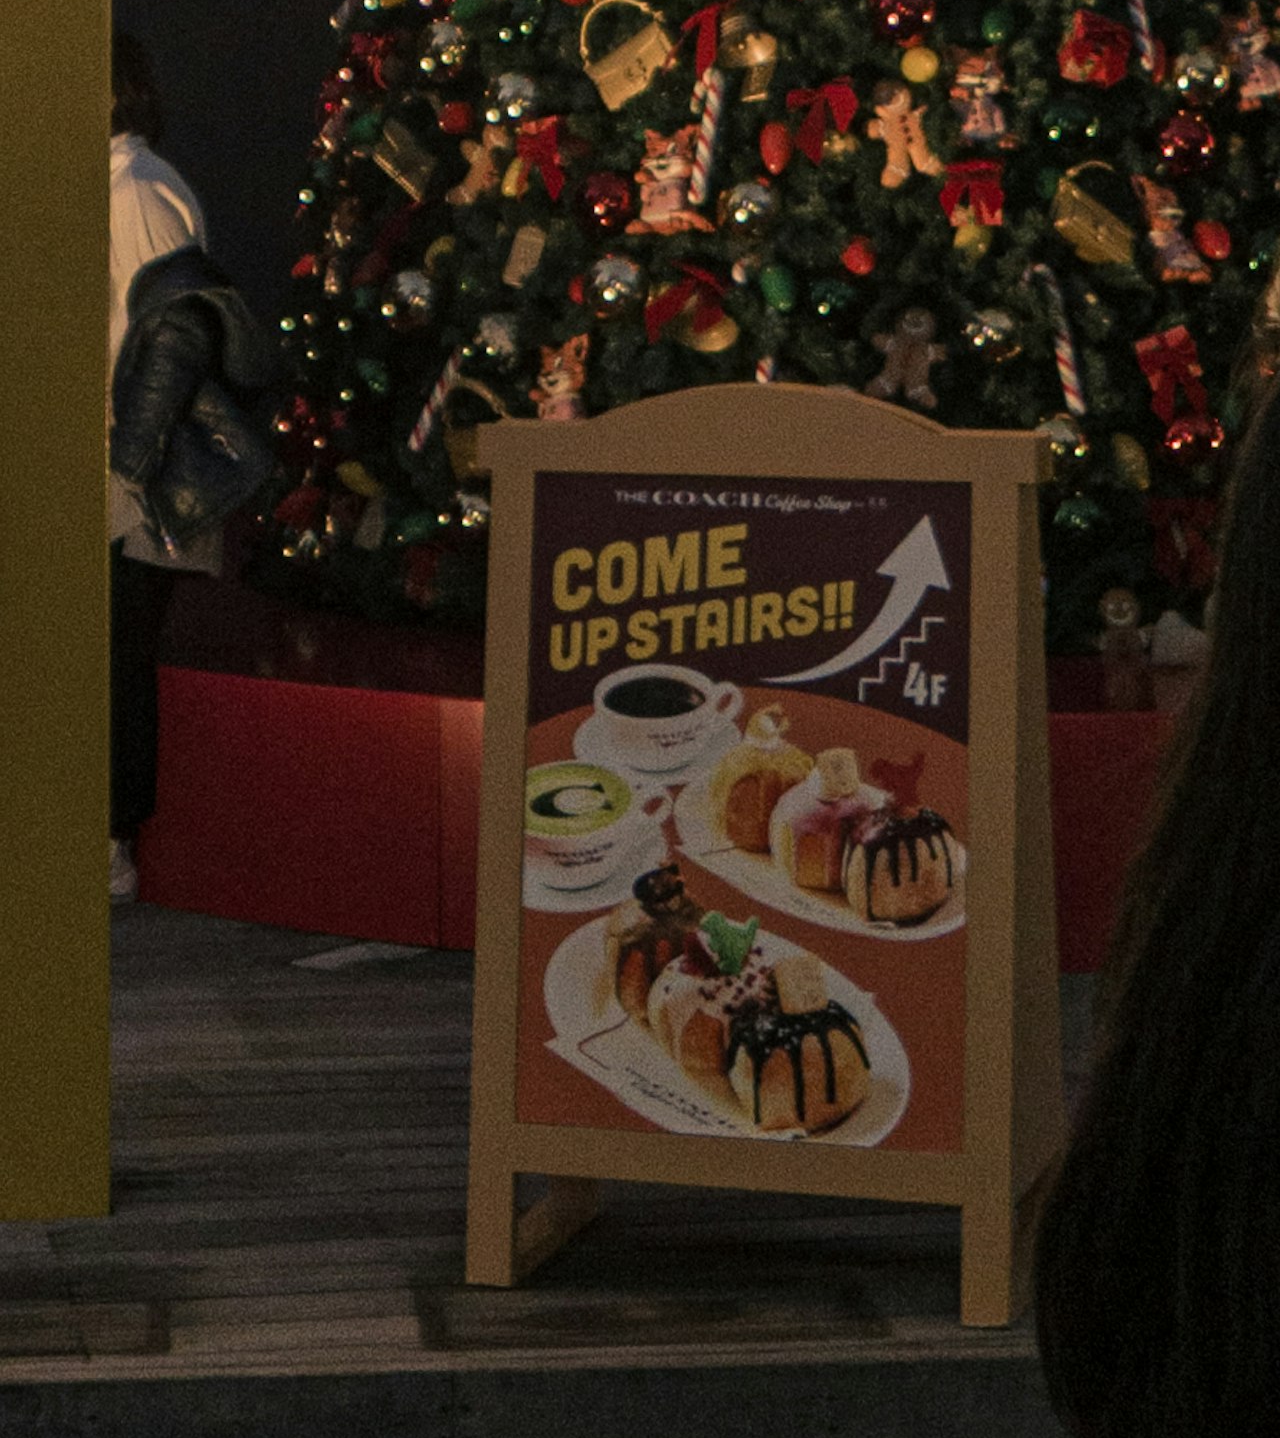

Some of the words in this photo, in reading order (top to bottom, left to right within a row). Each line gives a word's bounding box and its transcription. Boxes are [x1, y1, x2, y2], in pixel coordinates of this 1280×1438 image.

[615, 489, 648, 504] THE
[652, 490, 761, 508] COACH
[551, 523, 749, 612] COME
[903, 662, 949, 706] 4F
